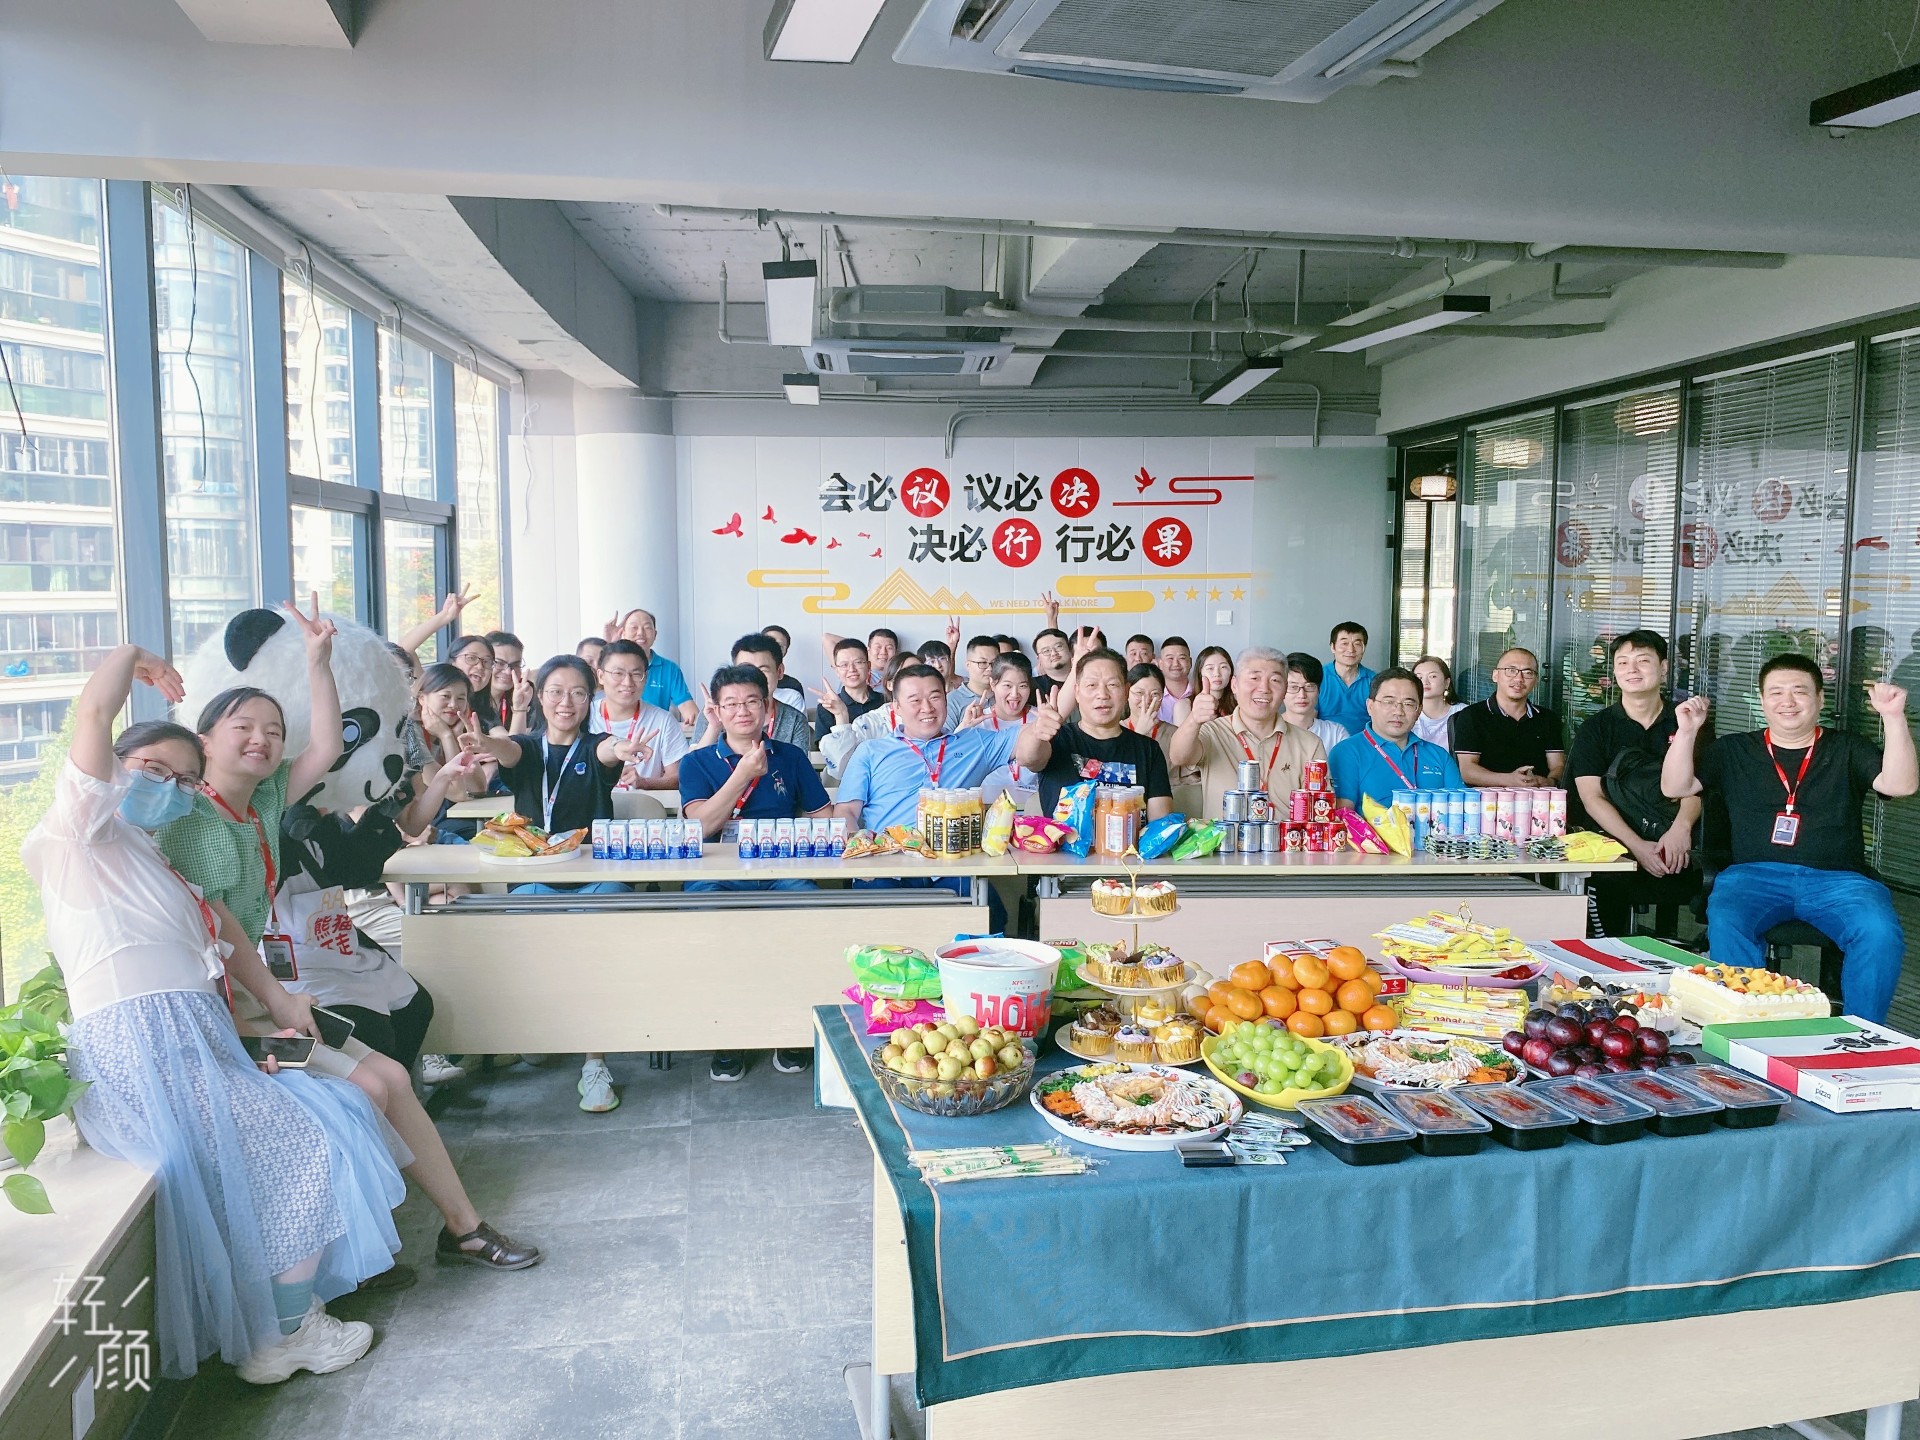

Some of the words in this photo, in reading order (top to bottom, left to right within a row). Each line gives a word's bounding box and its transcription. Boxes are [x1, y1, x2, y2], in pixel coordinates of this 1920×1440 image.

[819, 470, 945, 514] 会必议
[963, 472, 1091, 514] 议必决
[907, 523, 1034, 563] 决必行
[1055, 523, 1185, 563] 行必果
[990, 599, 1004, 607] WE
[1006, 599, 1030, 607] NEED
[1072, 598, 1098, 607] MORE
[314, 914, 353, 941] 熊猫
[970, 989, 1051, 1032] WOW
[1815, 1088, 1832, 1099] pizza
